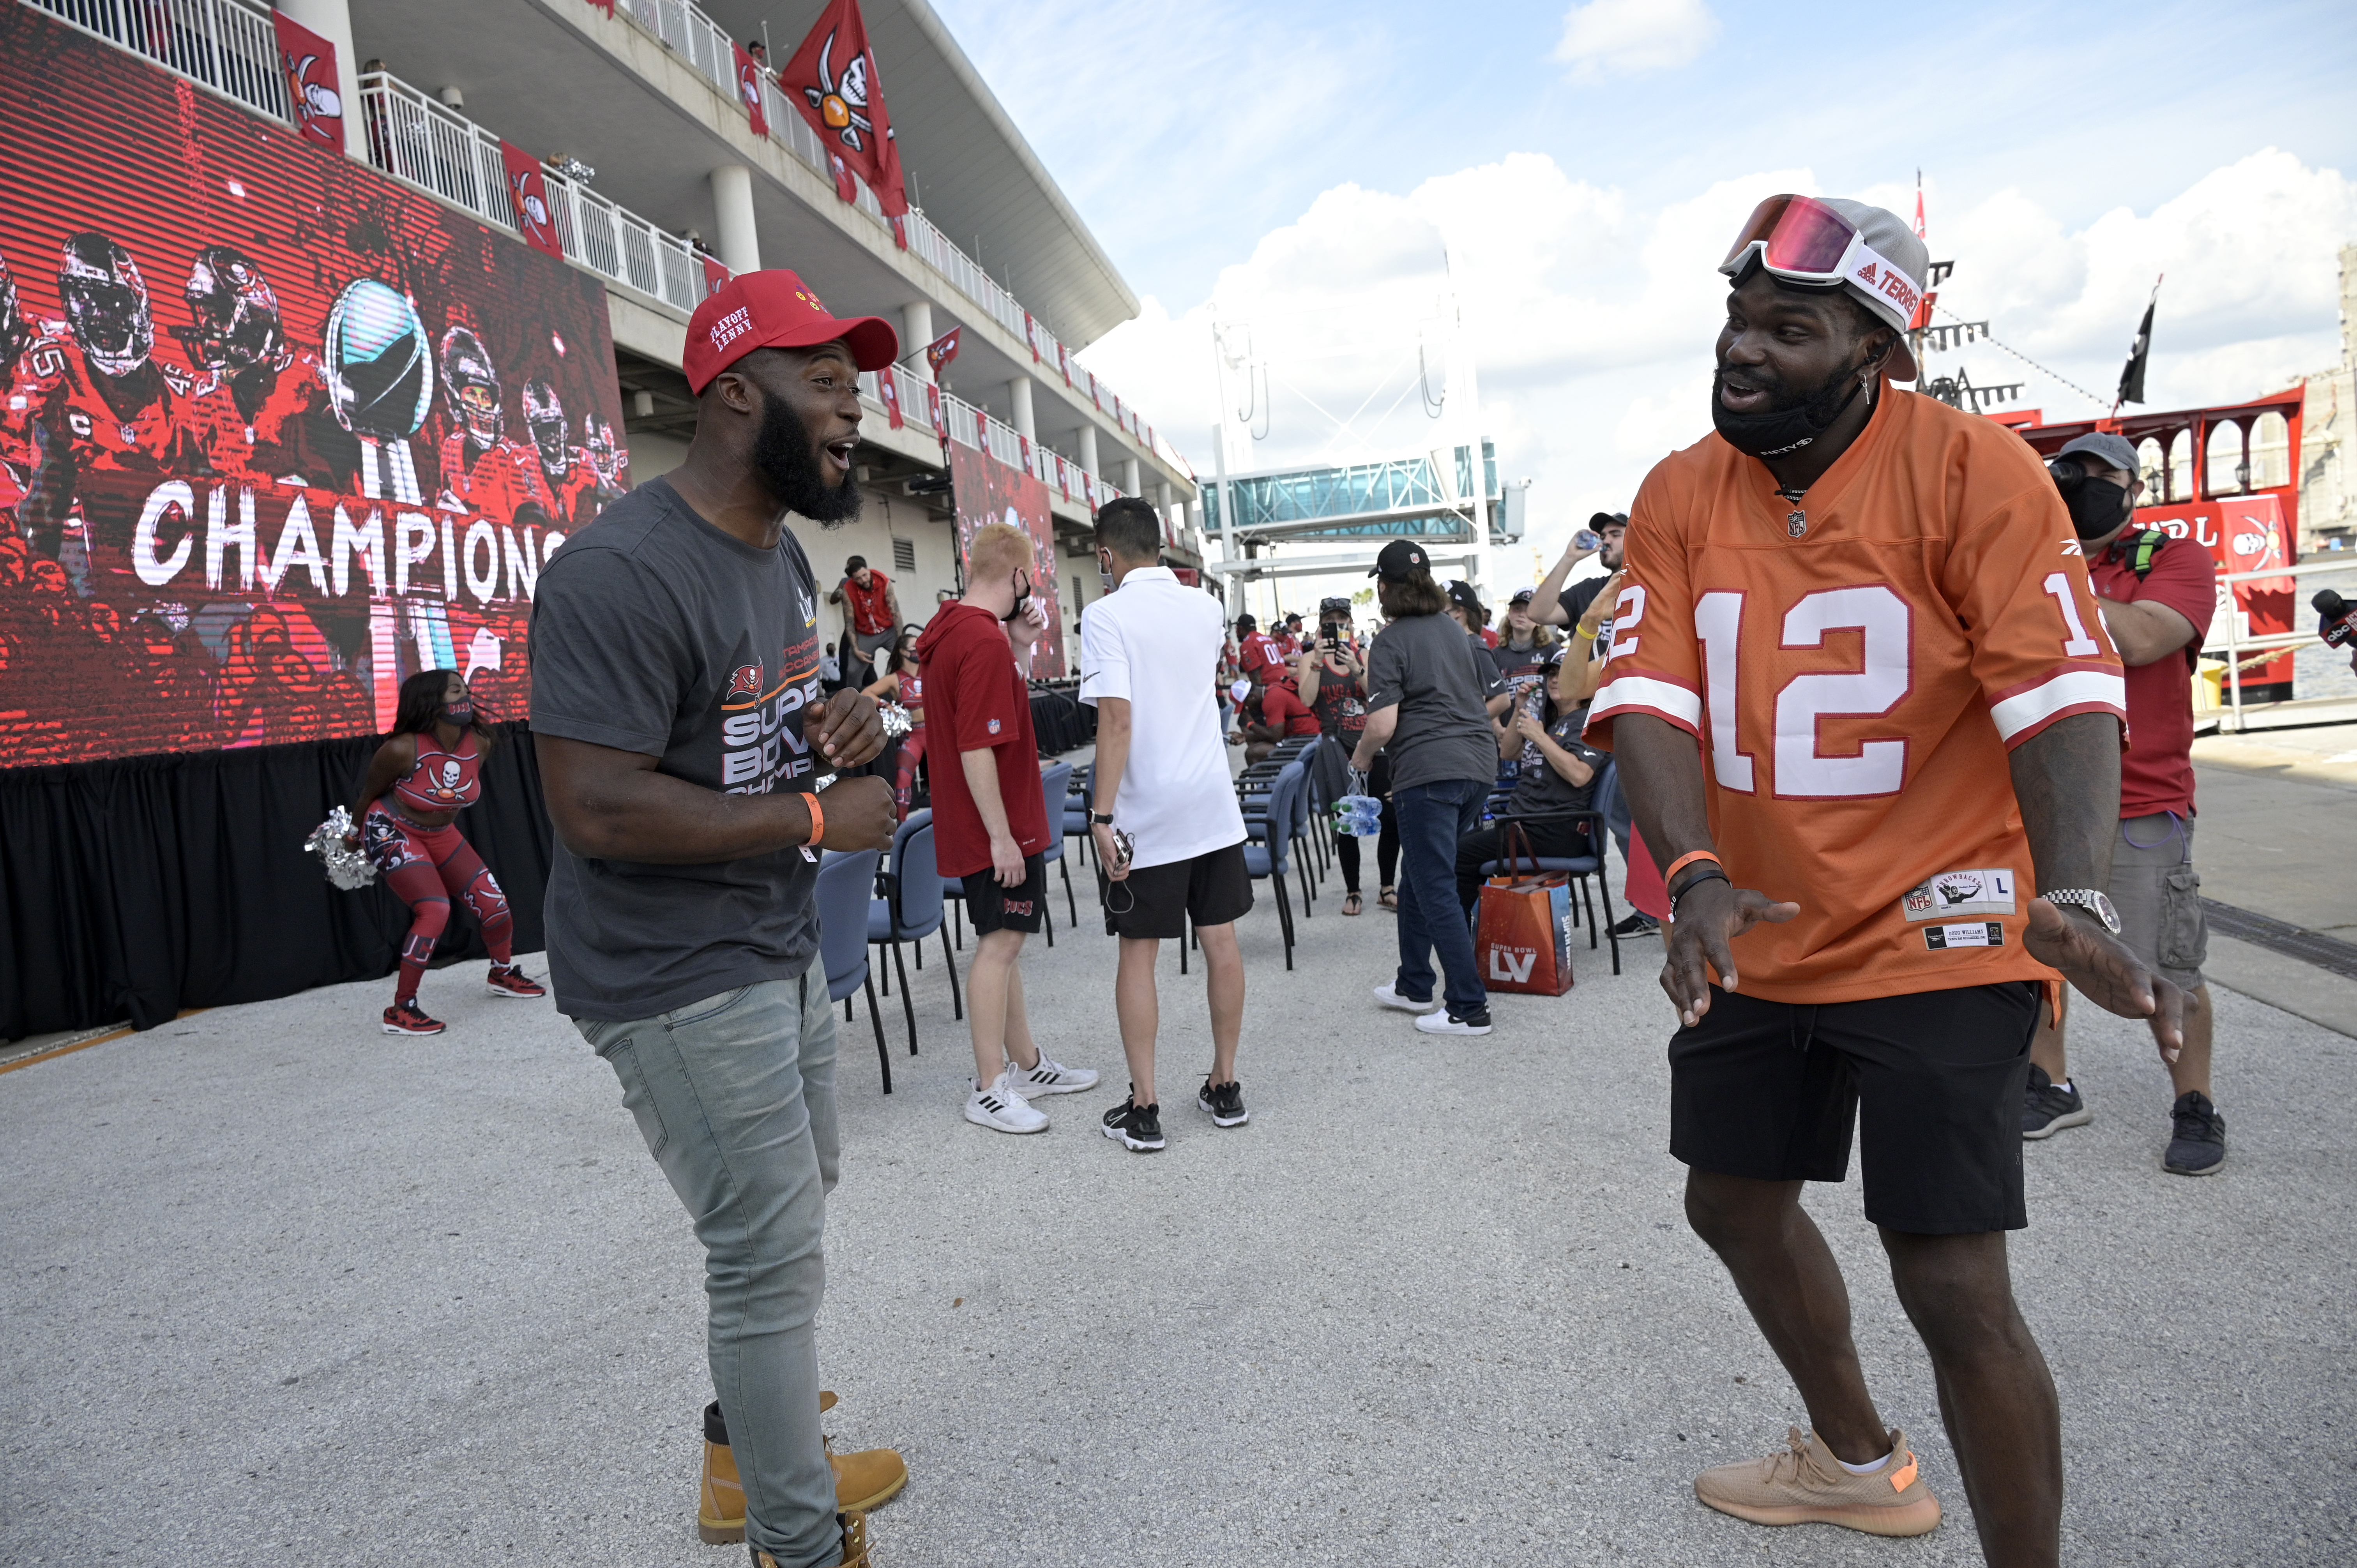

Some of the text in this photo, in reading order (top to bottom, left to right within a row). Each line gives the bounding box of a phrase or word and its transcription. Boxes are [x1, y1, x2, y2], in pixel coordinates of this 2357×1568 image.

[1857, 270, 1876, 285] adidas
[710, 306, 749, 343] PLAYOFF
[715, 319, 753, 353] LENNY
[1789, 522, 1804, 535] NFL
[2040, 570, 2121, 660] 1
[1600, 583, 1649, 672] 2
[2327, 625, 2350, 642] abc
[1694, 582, 1914, 801] 12
[1936, 874, 1982, 889] THROWBACKS
[1996, 878, 2008, 894] L
[1908, 896, 1931, 909] NFL
[1491, 943, 1512, 952] SUPER
[1489, 949, 1537, 984] LV
